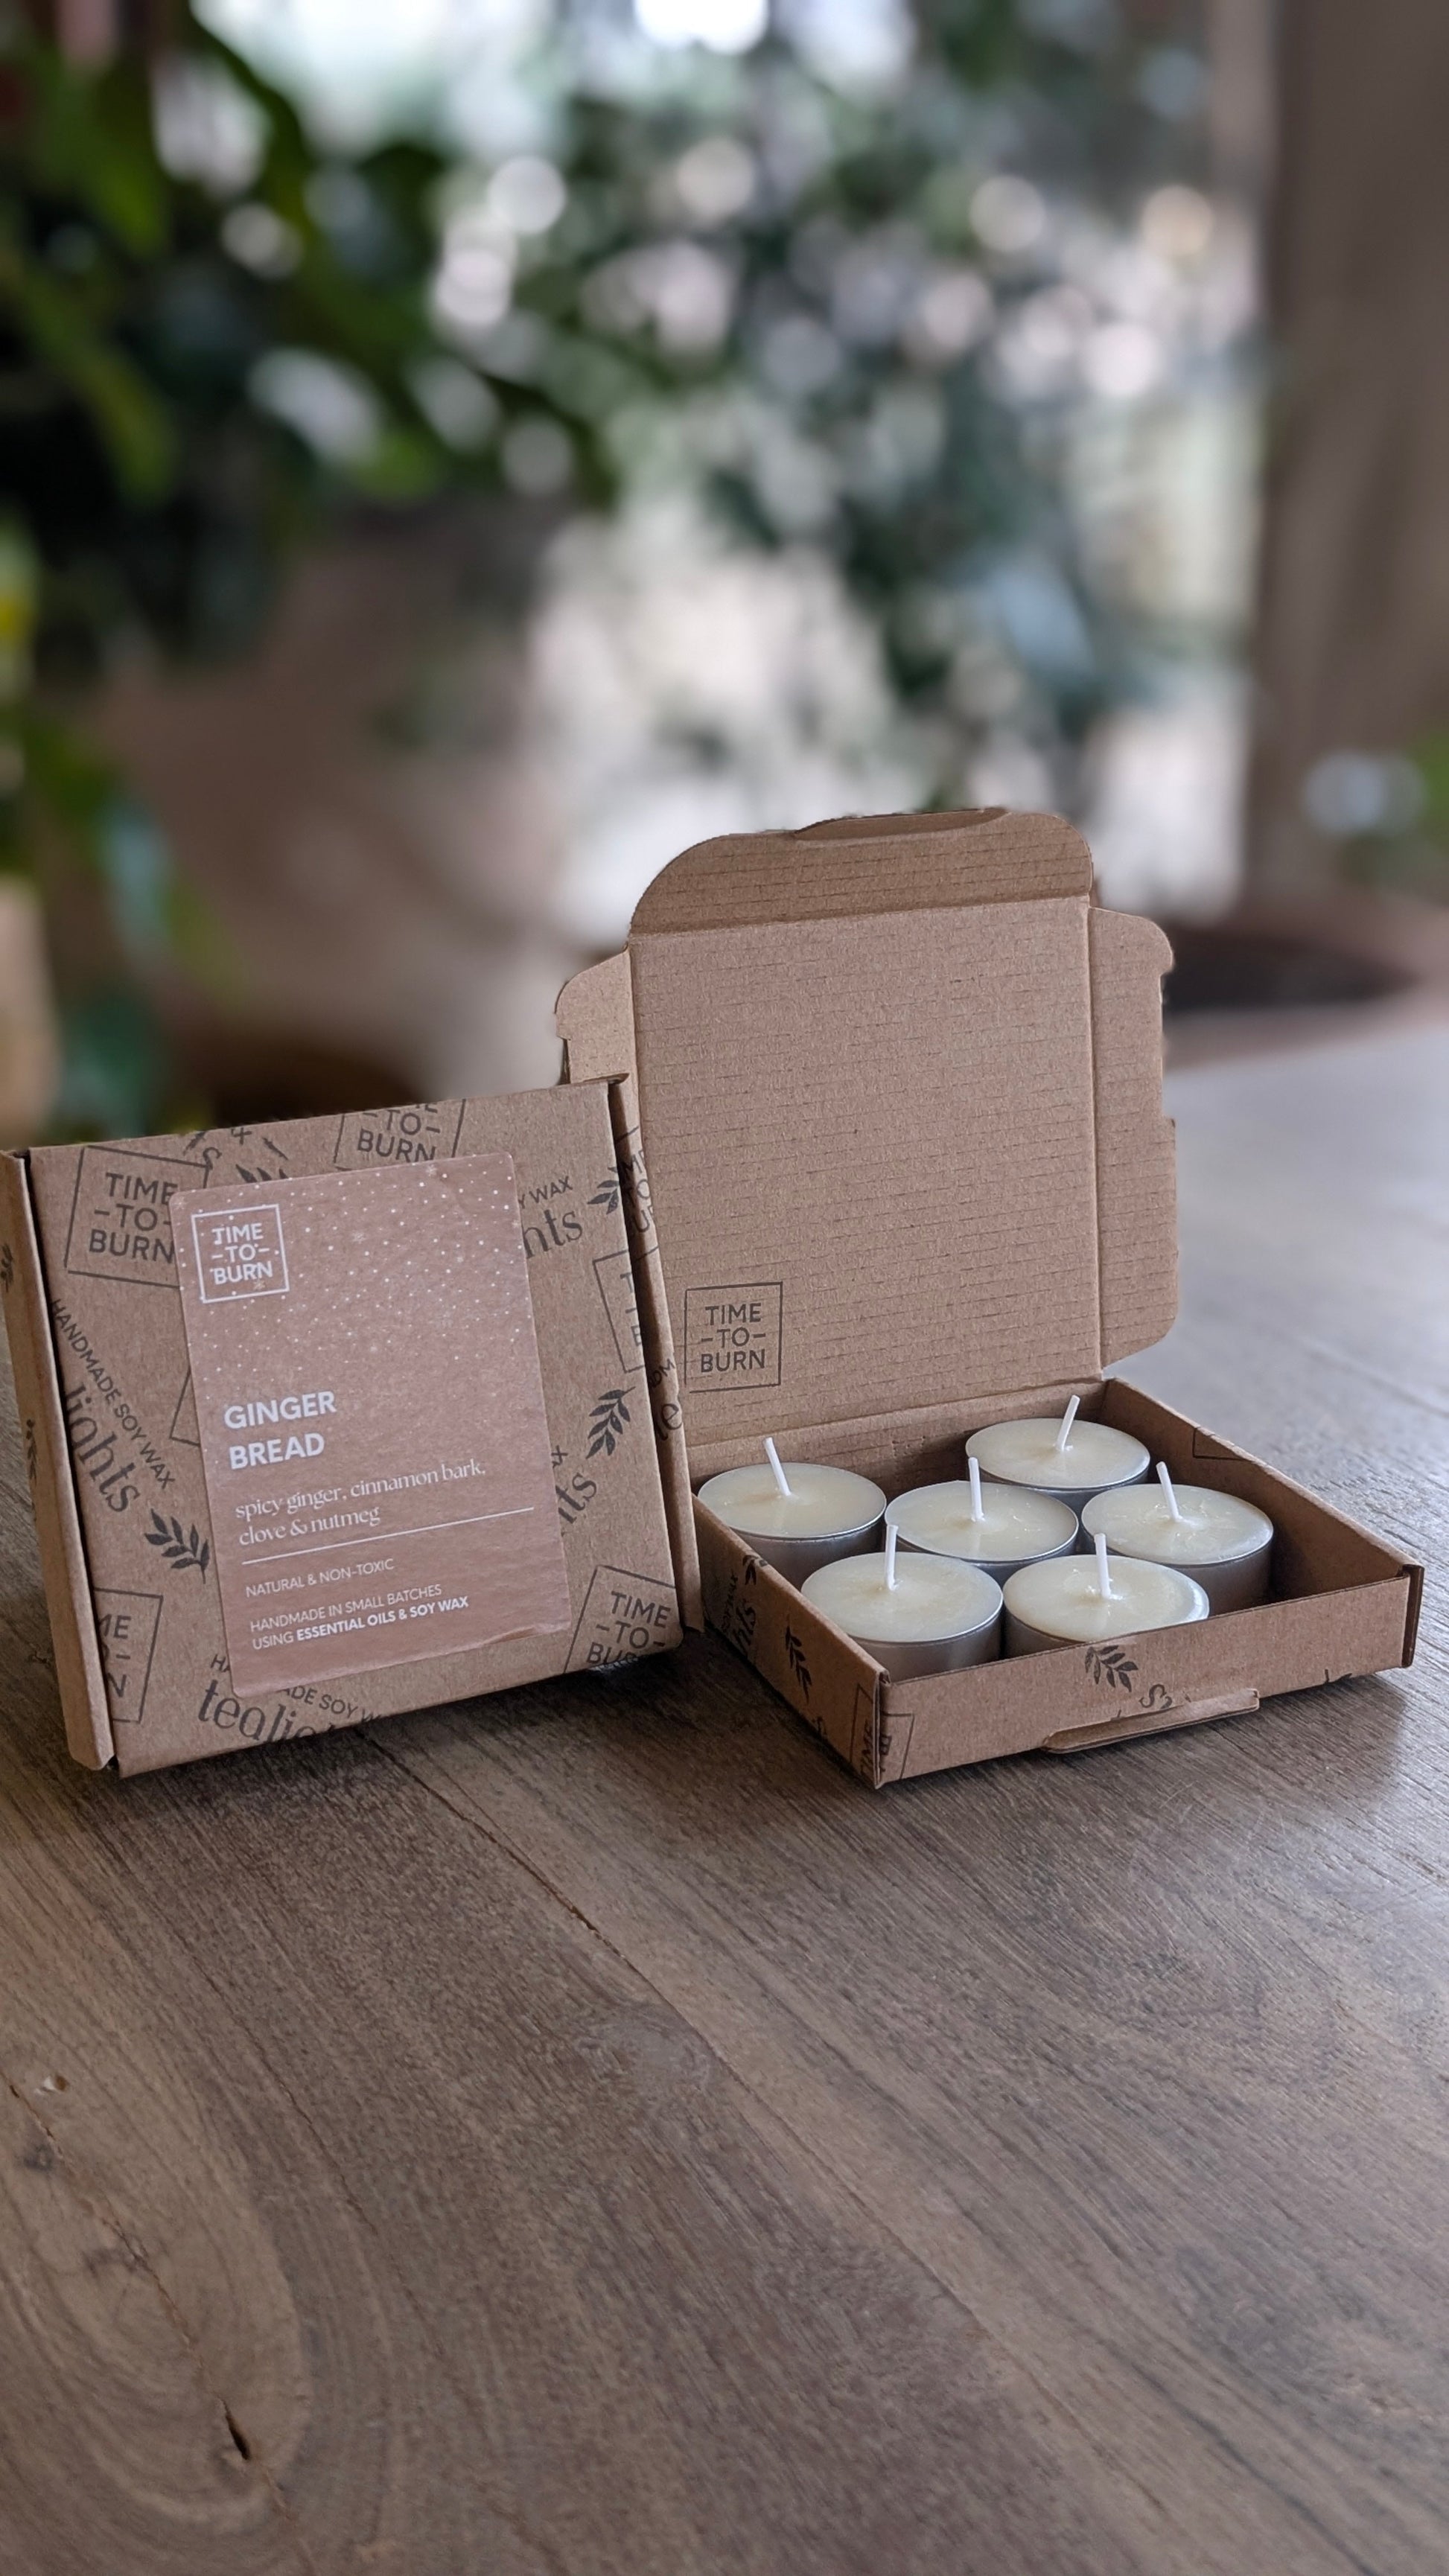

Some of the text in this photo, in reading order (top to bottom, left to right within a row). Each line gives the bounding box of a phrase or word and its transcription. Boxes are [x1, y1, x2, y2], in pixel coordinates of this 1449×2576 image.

[357, 1128, 436, 1162] BURN
[106, 1172, 178, 1205] TIME
[529, 1176, 573, 1203] WAX
[89, 1229, 174, 1263] BURN
[211, 1222, 264, 1245] TIME
[213, 1260, 273, 1284] BURN
[705, 1303, 761, 1325] TIME
[701, 1348, 765, 1373] BURN
[53, 1299, 176, 1490] HANDMADE SOY WAX
[224, 1391, 337, 1429] GINGER
[229, 1432, 325, 1470] BREAD
[235, 1498, 283, 1522] spicy
[350, 1470, 439, 1497] cinnamon
[239, 1506, 380, 1546] clove & nutmeg
[246, 1558, 395, 1598] NATURAL & NON-TOXIC
[250, 1584, 442, 1632] HANDMADE IN SMALL BATCHES
[252, 1595, 469, 1650] USING ESSENTIAL OILS & SOY WAX
[611, 1590, 671, 1628] TIME
[319, 1694, 358, 1719] SOY
